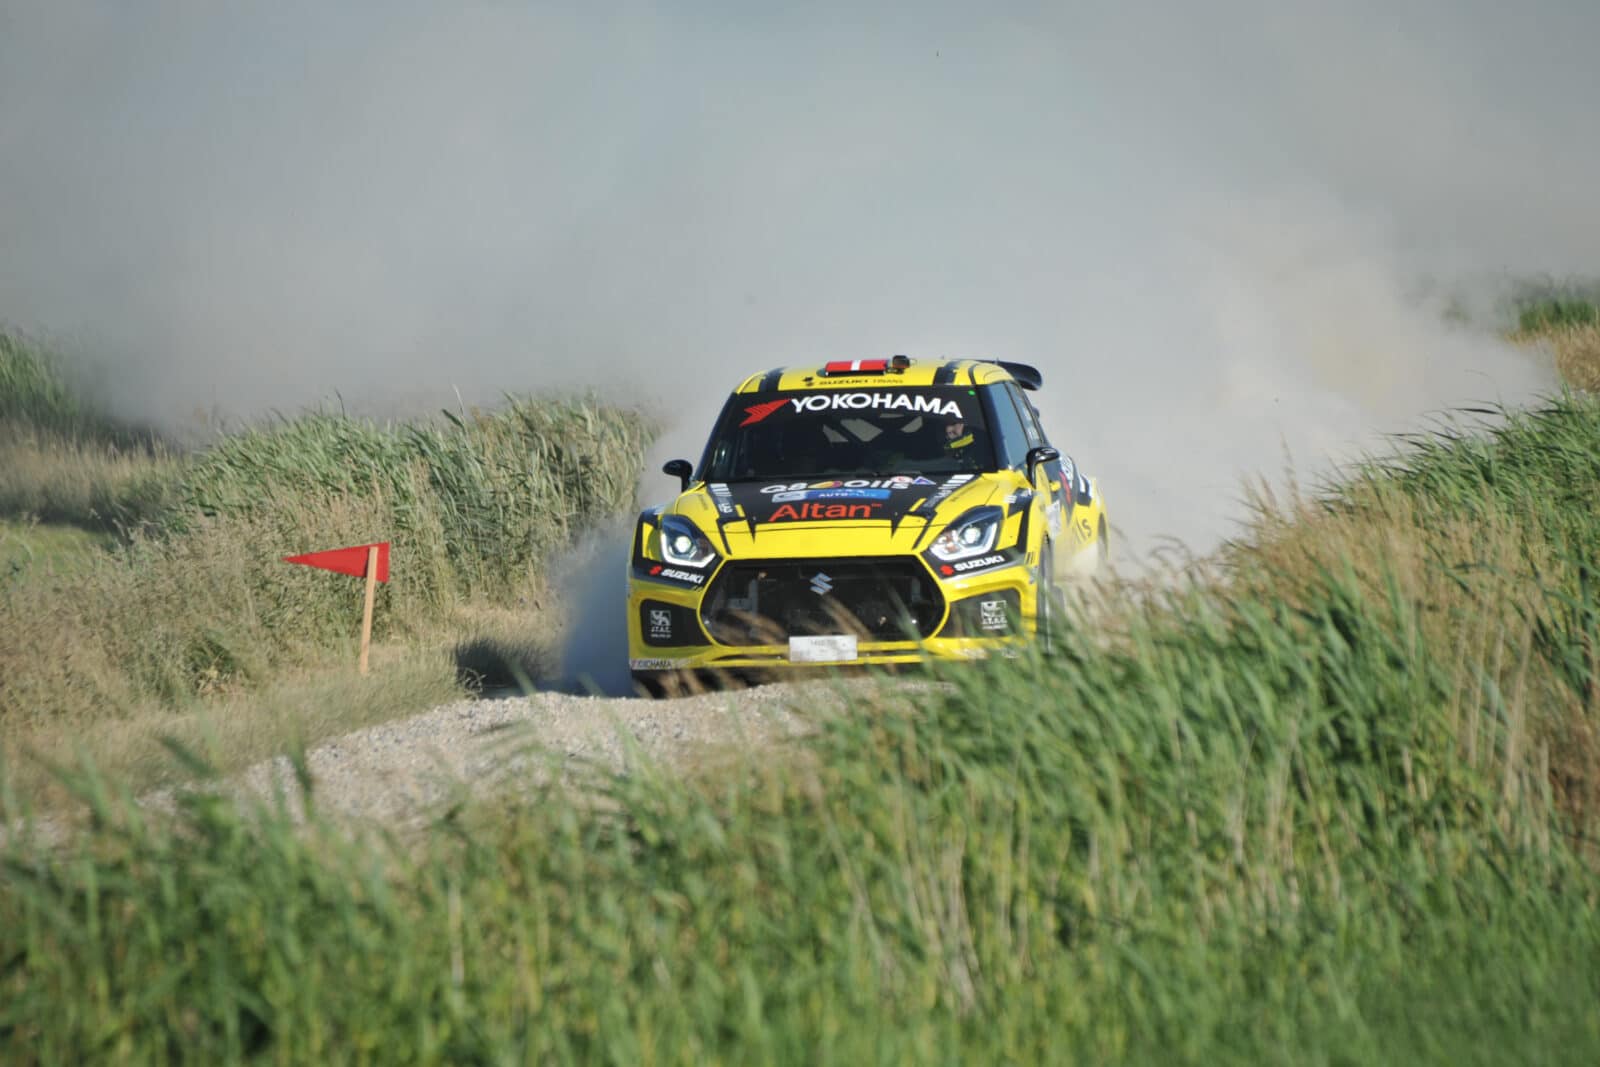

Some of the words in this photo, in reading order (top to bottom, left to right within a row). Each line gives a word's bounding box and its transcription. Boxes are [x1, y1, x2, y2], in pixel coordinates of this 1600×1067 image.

[791, 392, 963, 419] YOKOHAMA
[760, 482, 808, 494] Q8
[954, 554, 1006, 571] SUZUKI
[661, 568, 704, 585] SUZUKI
